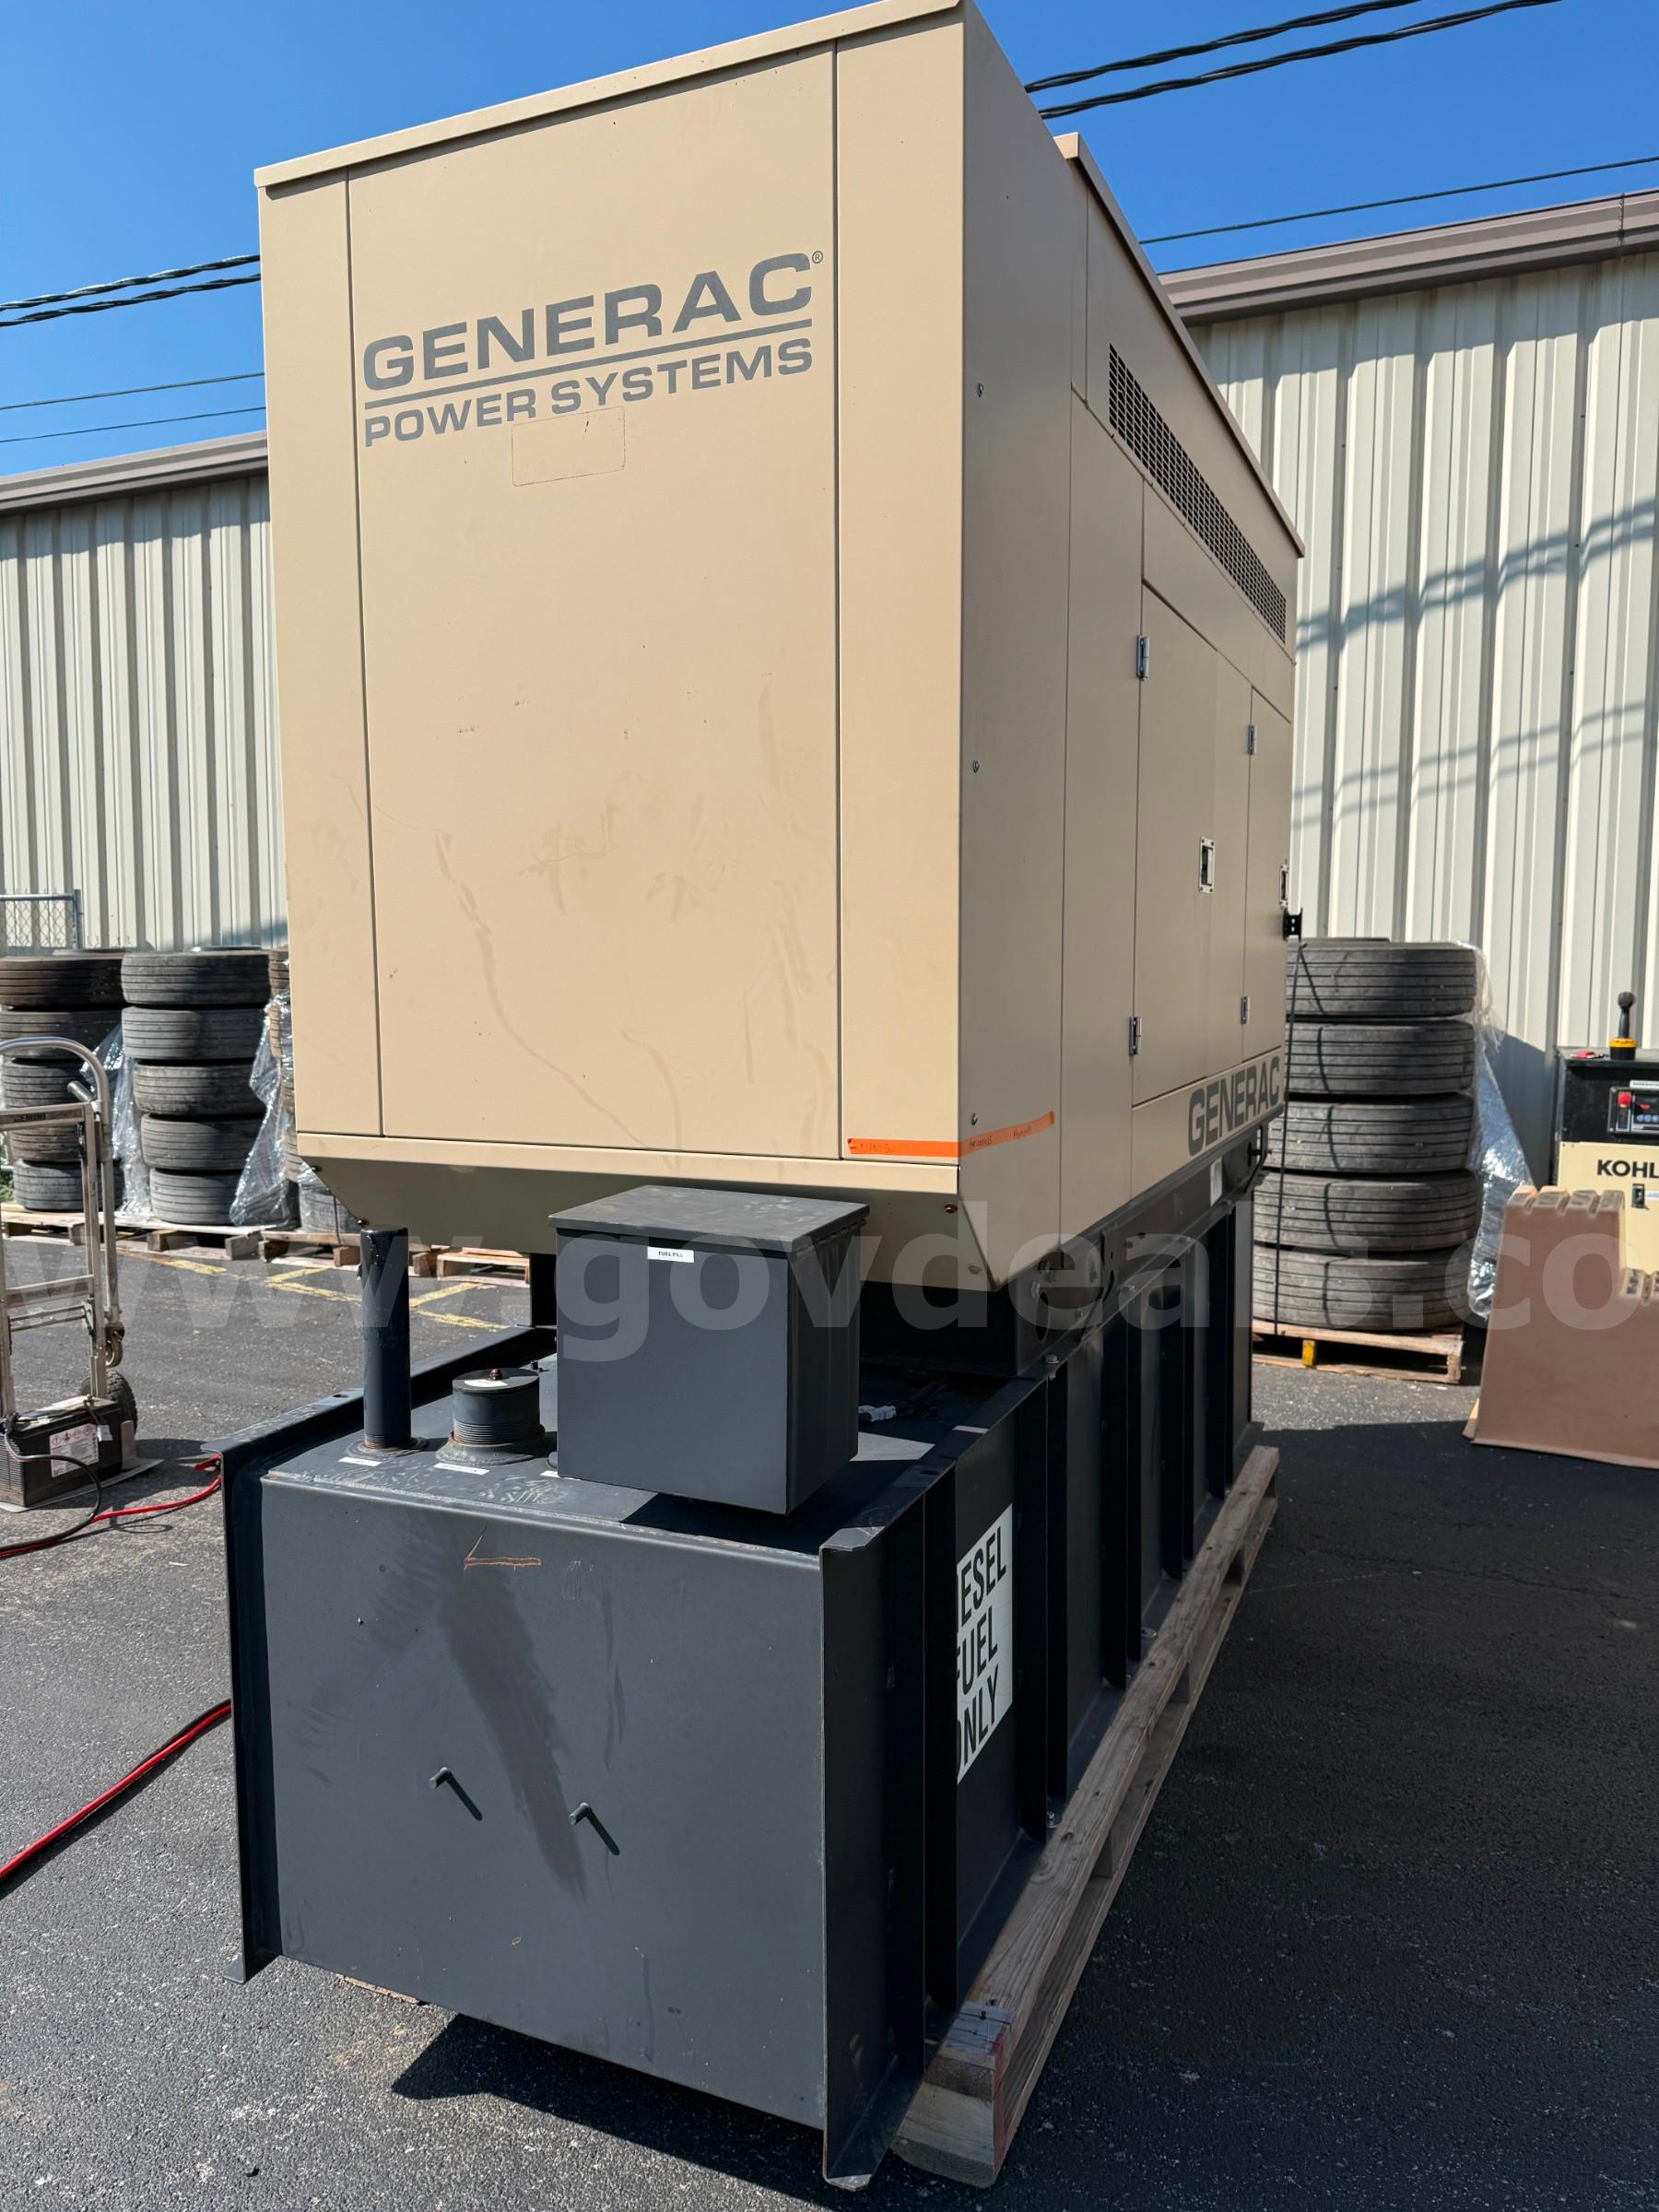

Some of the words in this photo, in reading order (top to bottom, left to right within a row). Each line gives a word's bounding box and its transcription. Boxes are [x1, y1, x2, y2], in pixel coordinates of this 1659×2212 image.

[365, 388, 536, 448] POWER
[551, 337, 812, 415] SYSTEMS
[1187, 1055, 1280, 1156] GENERAC
[959, 1525, 1006, 1627] ESEL
